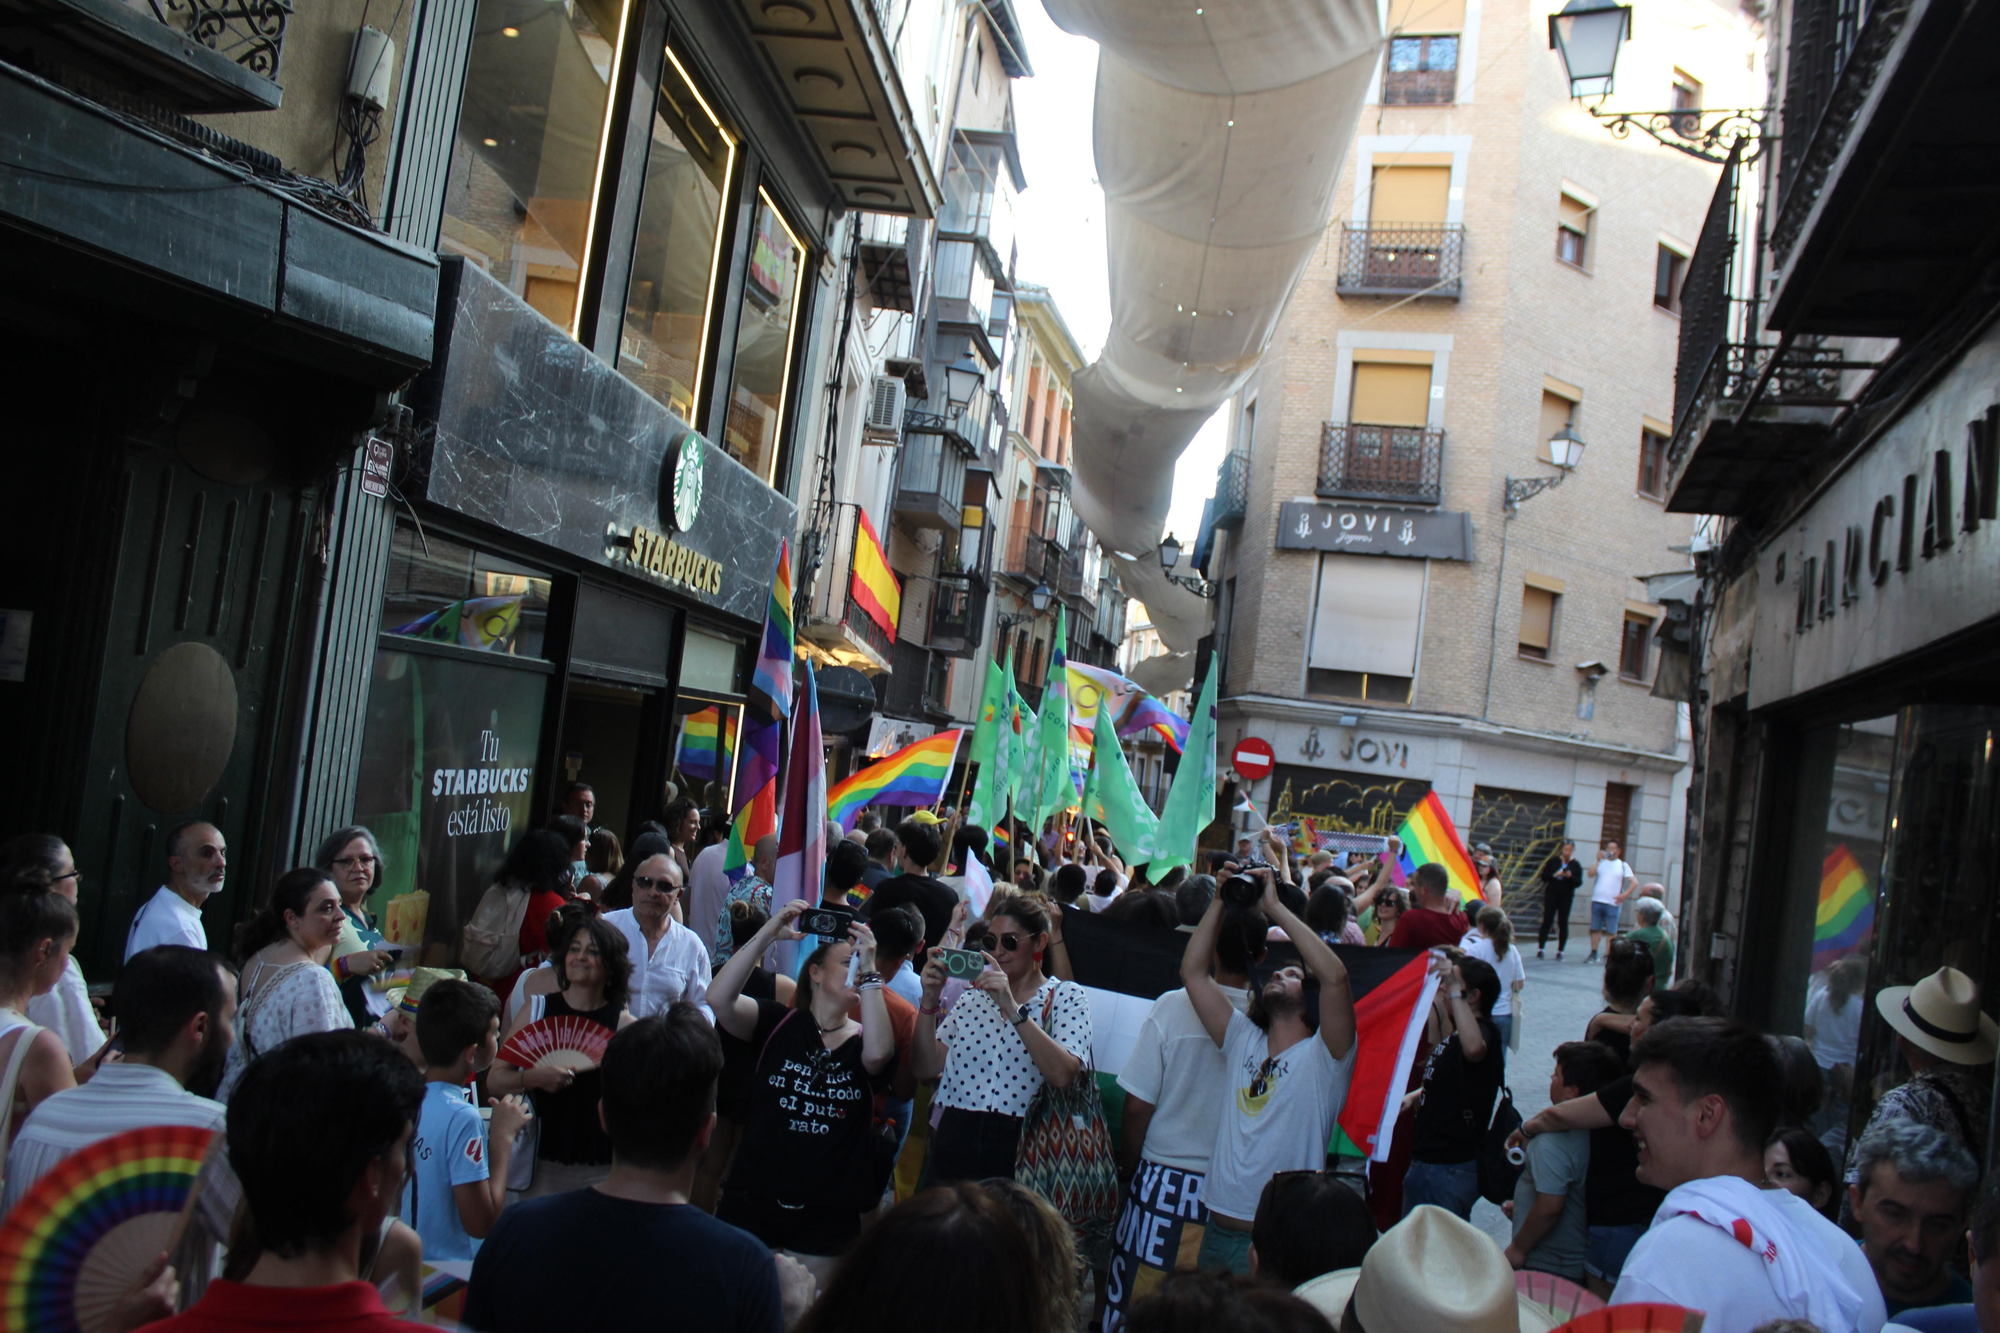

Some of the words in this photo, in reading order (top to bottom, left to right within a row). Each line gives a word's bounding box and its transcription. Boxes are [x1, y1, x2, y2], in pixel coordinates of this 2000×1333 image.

[1321, 512, 1391, 533] JOVI
[629, 524, 723, 595] STARBUCKS
[481, 729, 500, 762] Tu
[1340, 733, 1409, 769] JOVI
[431, 768, 530, 797] STARBUCKS
[447, 800, 479, 836] está
[480, 798, 511, 833] listo
[768, 1074, 787, 1088] en
[781, 1059, 853, 1084] penndo
[779, 1095, 798, 1111] el
[788, 1119, 830, 1135] rato
[1115, 1197, 1172, 1267] ONE
